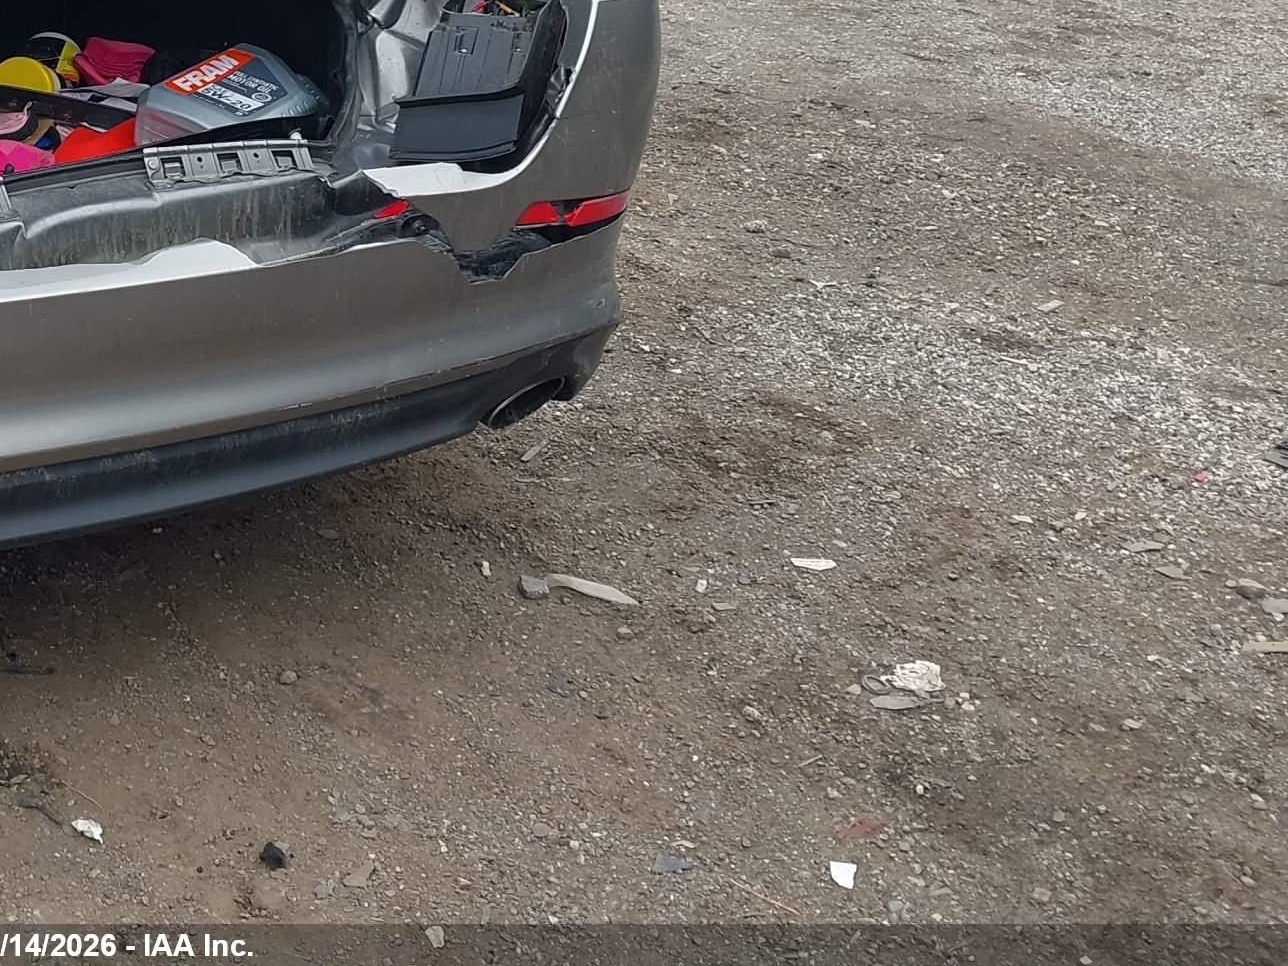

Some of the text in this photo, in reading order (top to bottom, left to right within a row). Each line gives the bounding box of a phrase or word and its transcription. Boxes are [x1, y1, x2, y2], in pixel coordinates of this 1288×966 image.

[173, 54, 240, 92] FRAM
[226, 74, 258, 89] MOTOR
[256, 82, 273, 94] OIL
[200, 89, 252, 110] 5W-20
